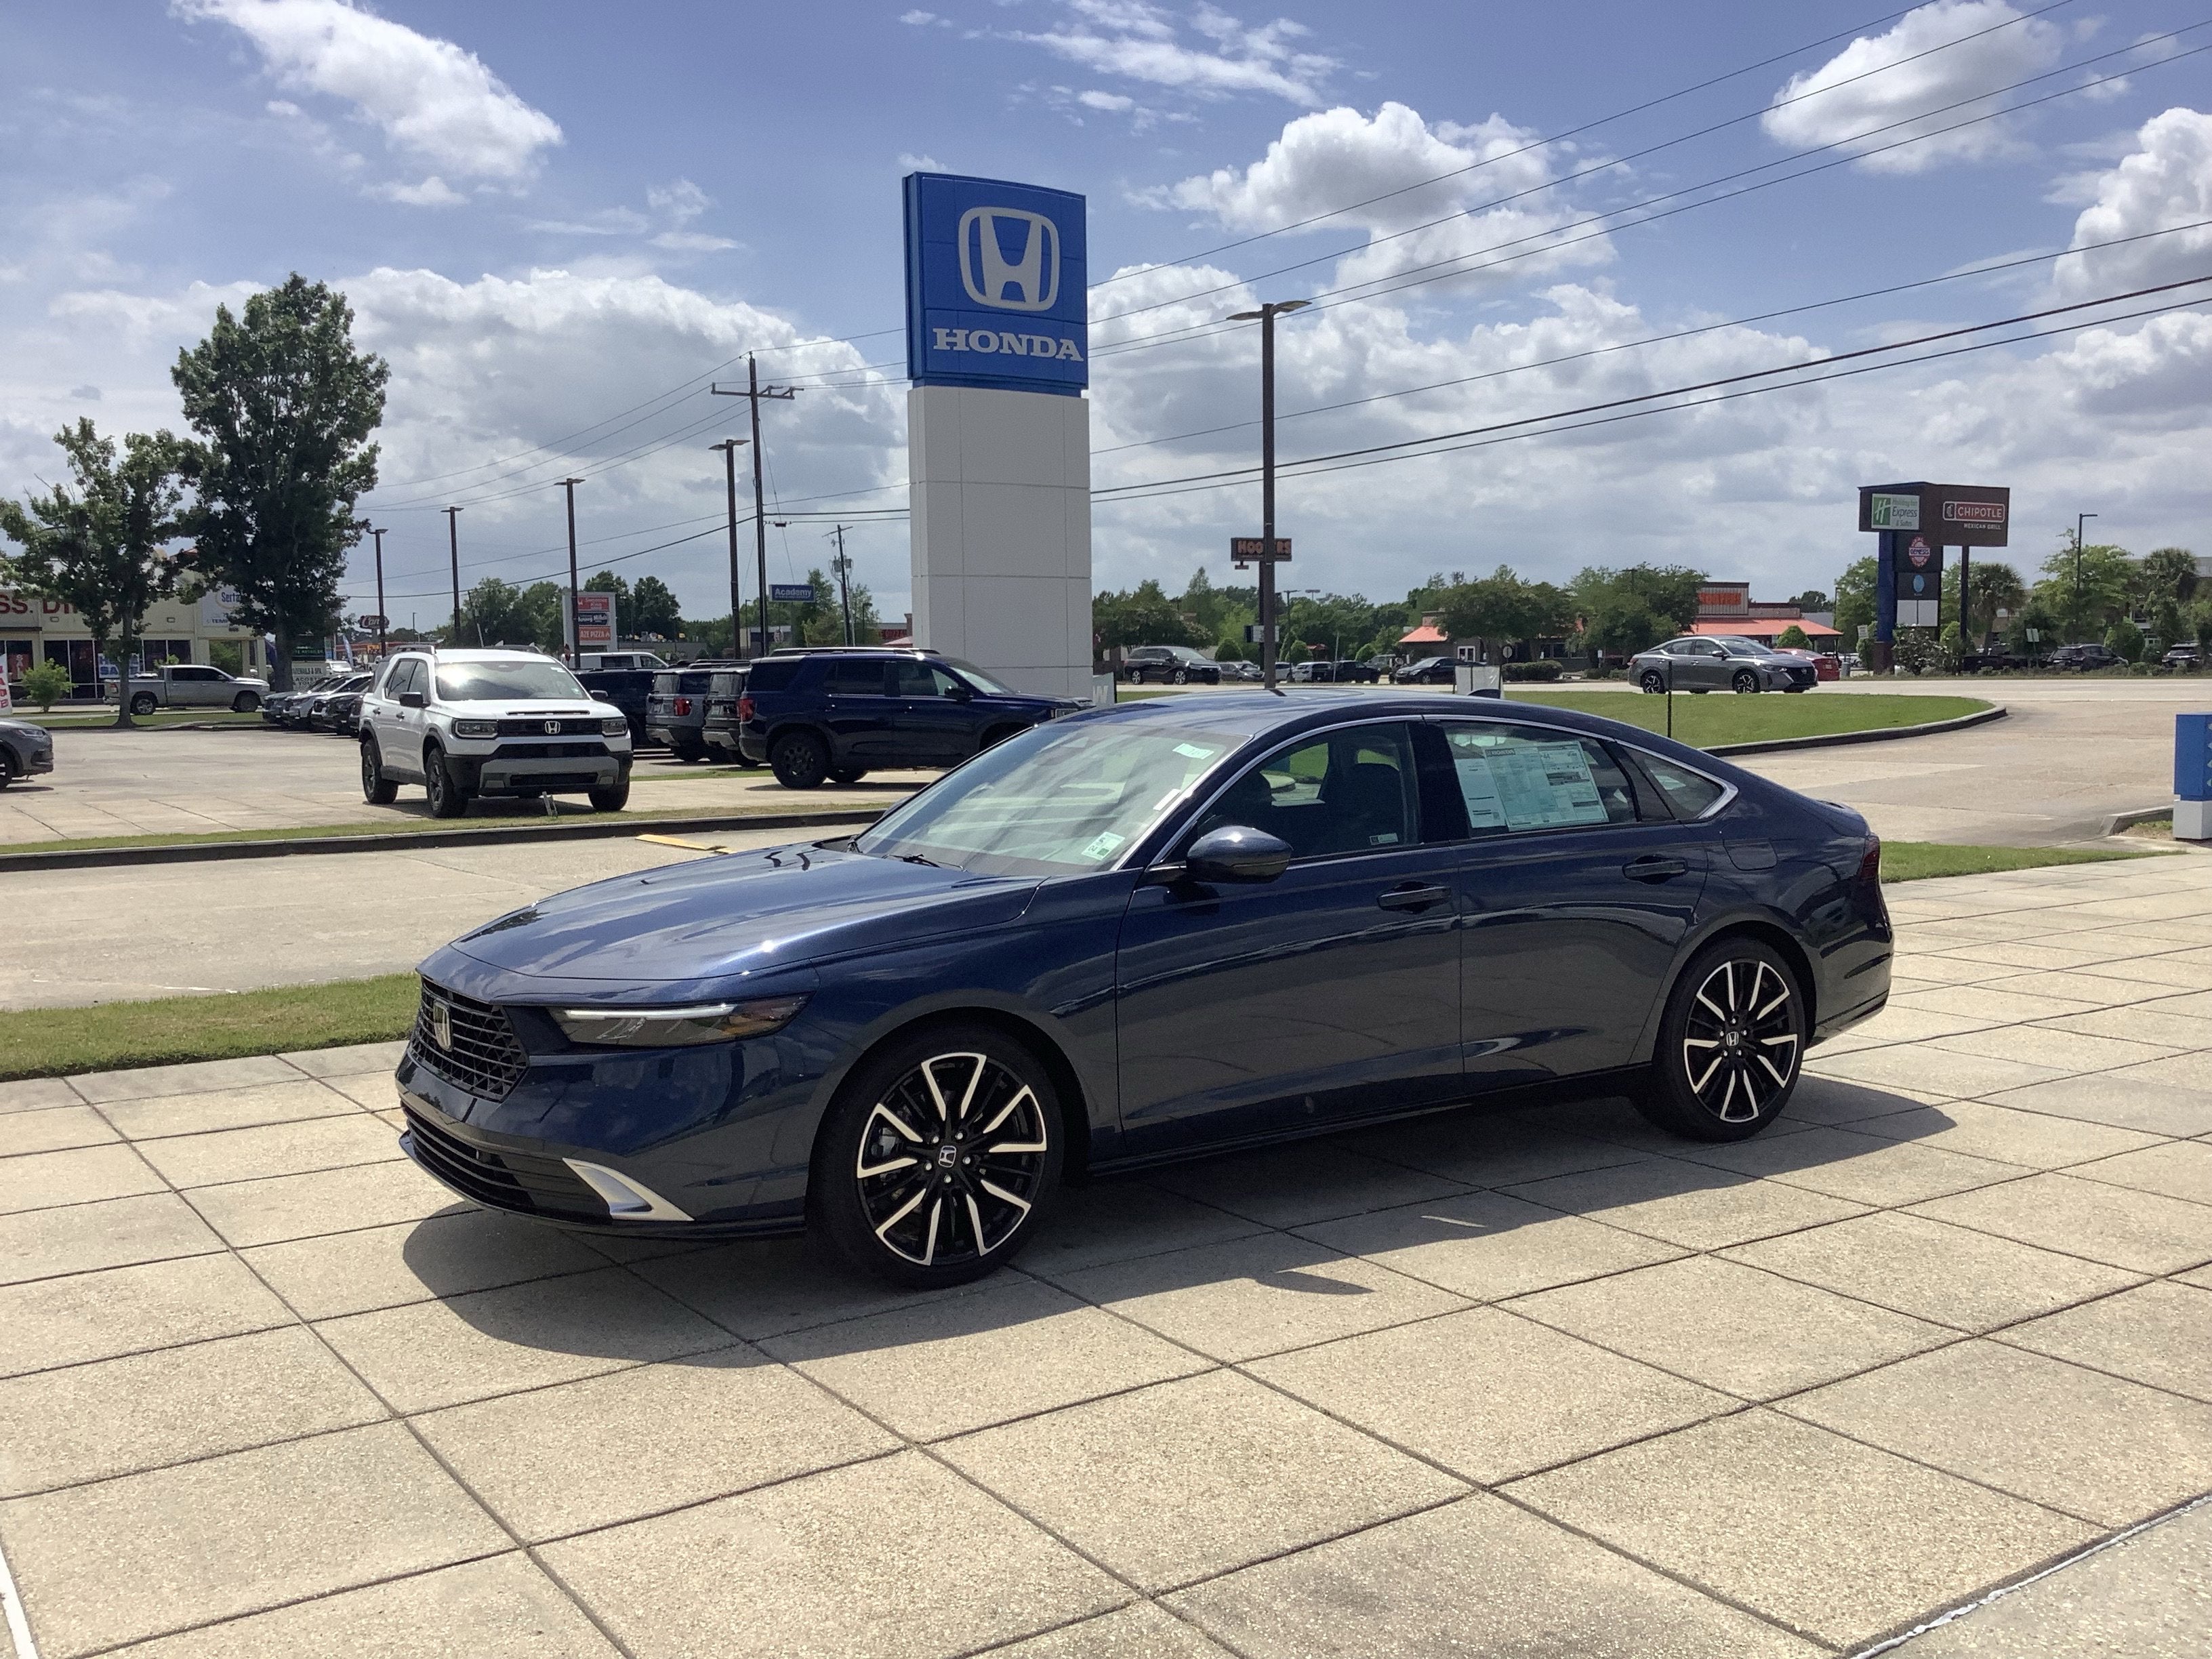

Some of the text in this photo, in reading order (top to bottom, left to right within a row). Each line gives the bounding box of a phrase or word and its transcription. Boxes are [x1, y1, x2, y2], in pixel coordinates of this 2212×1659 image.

[933, 327, 1084, 362] HONDA
[1892, 506, 1918, 518] Express
[1957, 506, 2003, 518] CHIPOTLE
[1237, 540, 1291, 554] HOORS
[775, 588, 812, 598] Academy
